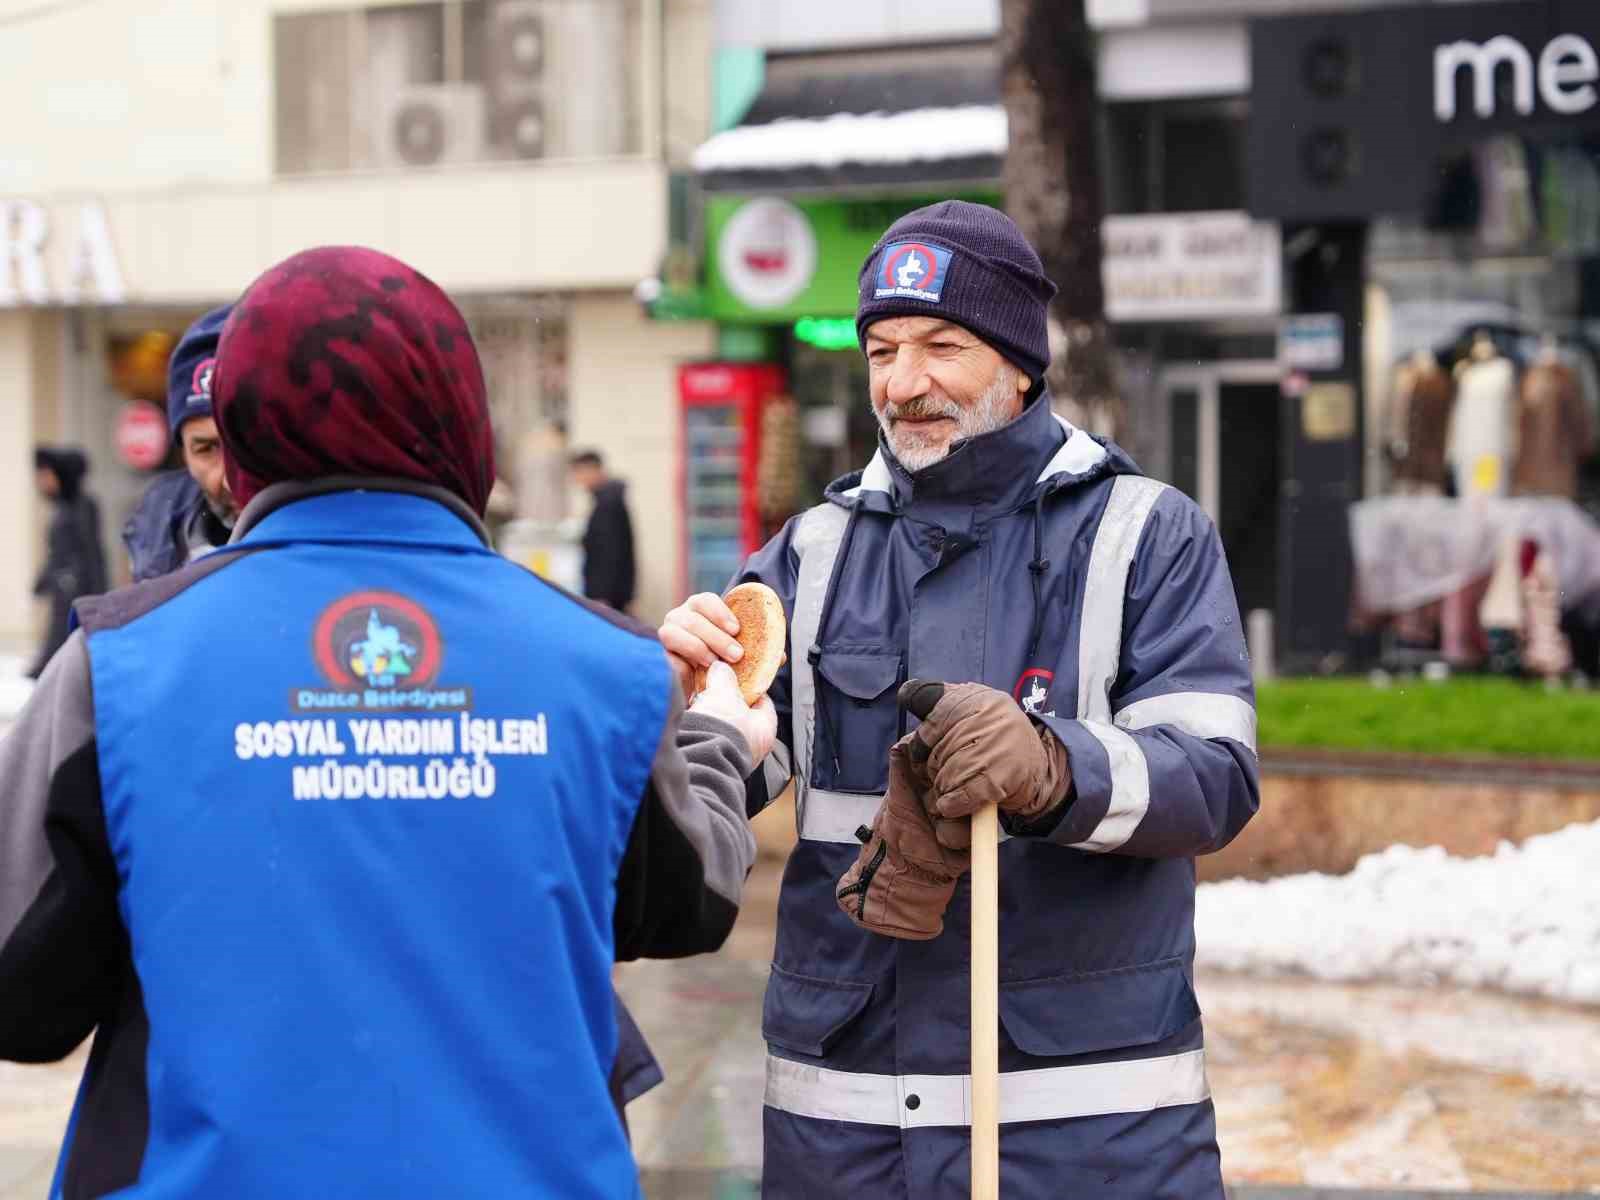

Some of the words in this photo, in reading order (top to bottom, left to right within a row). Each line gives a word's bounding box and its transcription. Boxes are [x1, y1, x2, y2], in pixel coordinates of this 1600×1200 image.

[1433, 34, 1599, 122] me
[234, 719, 346, 759] SOSYAL
[348, 718, 455, 755] YARDIM
[459, 711, 549, 764] İŞLERİ
[292, 759, 496, 800] MÜDÜRLÜĞÜ
